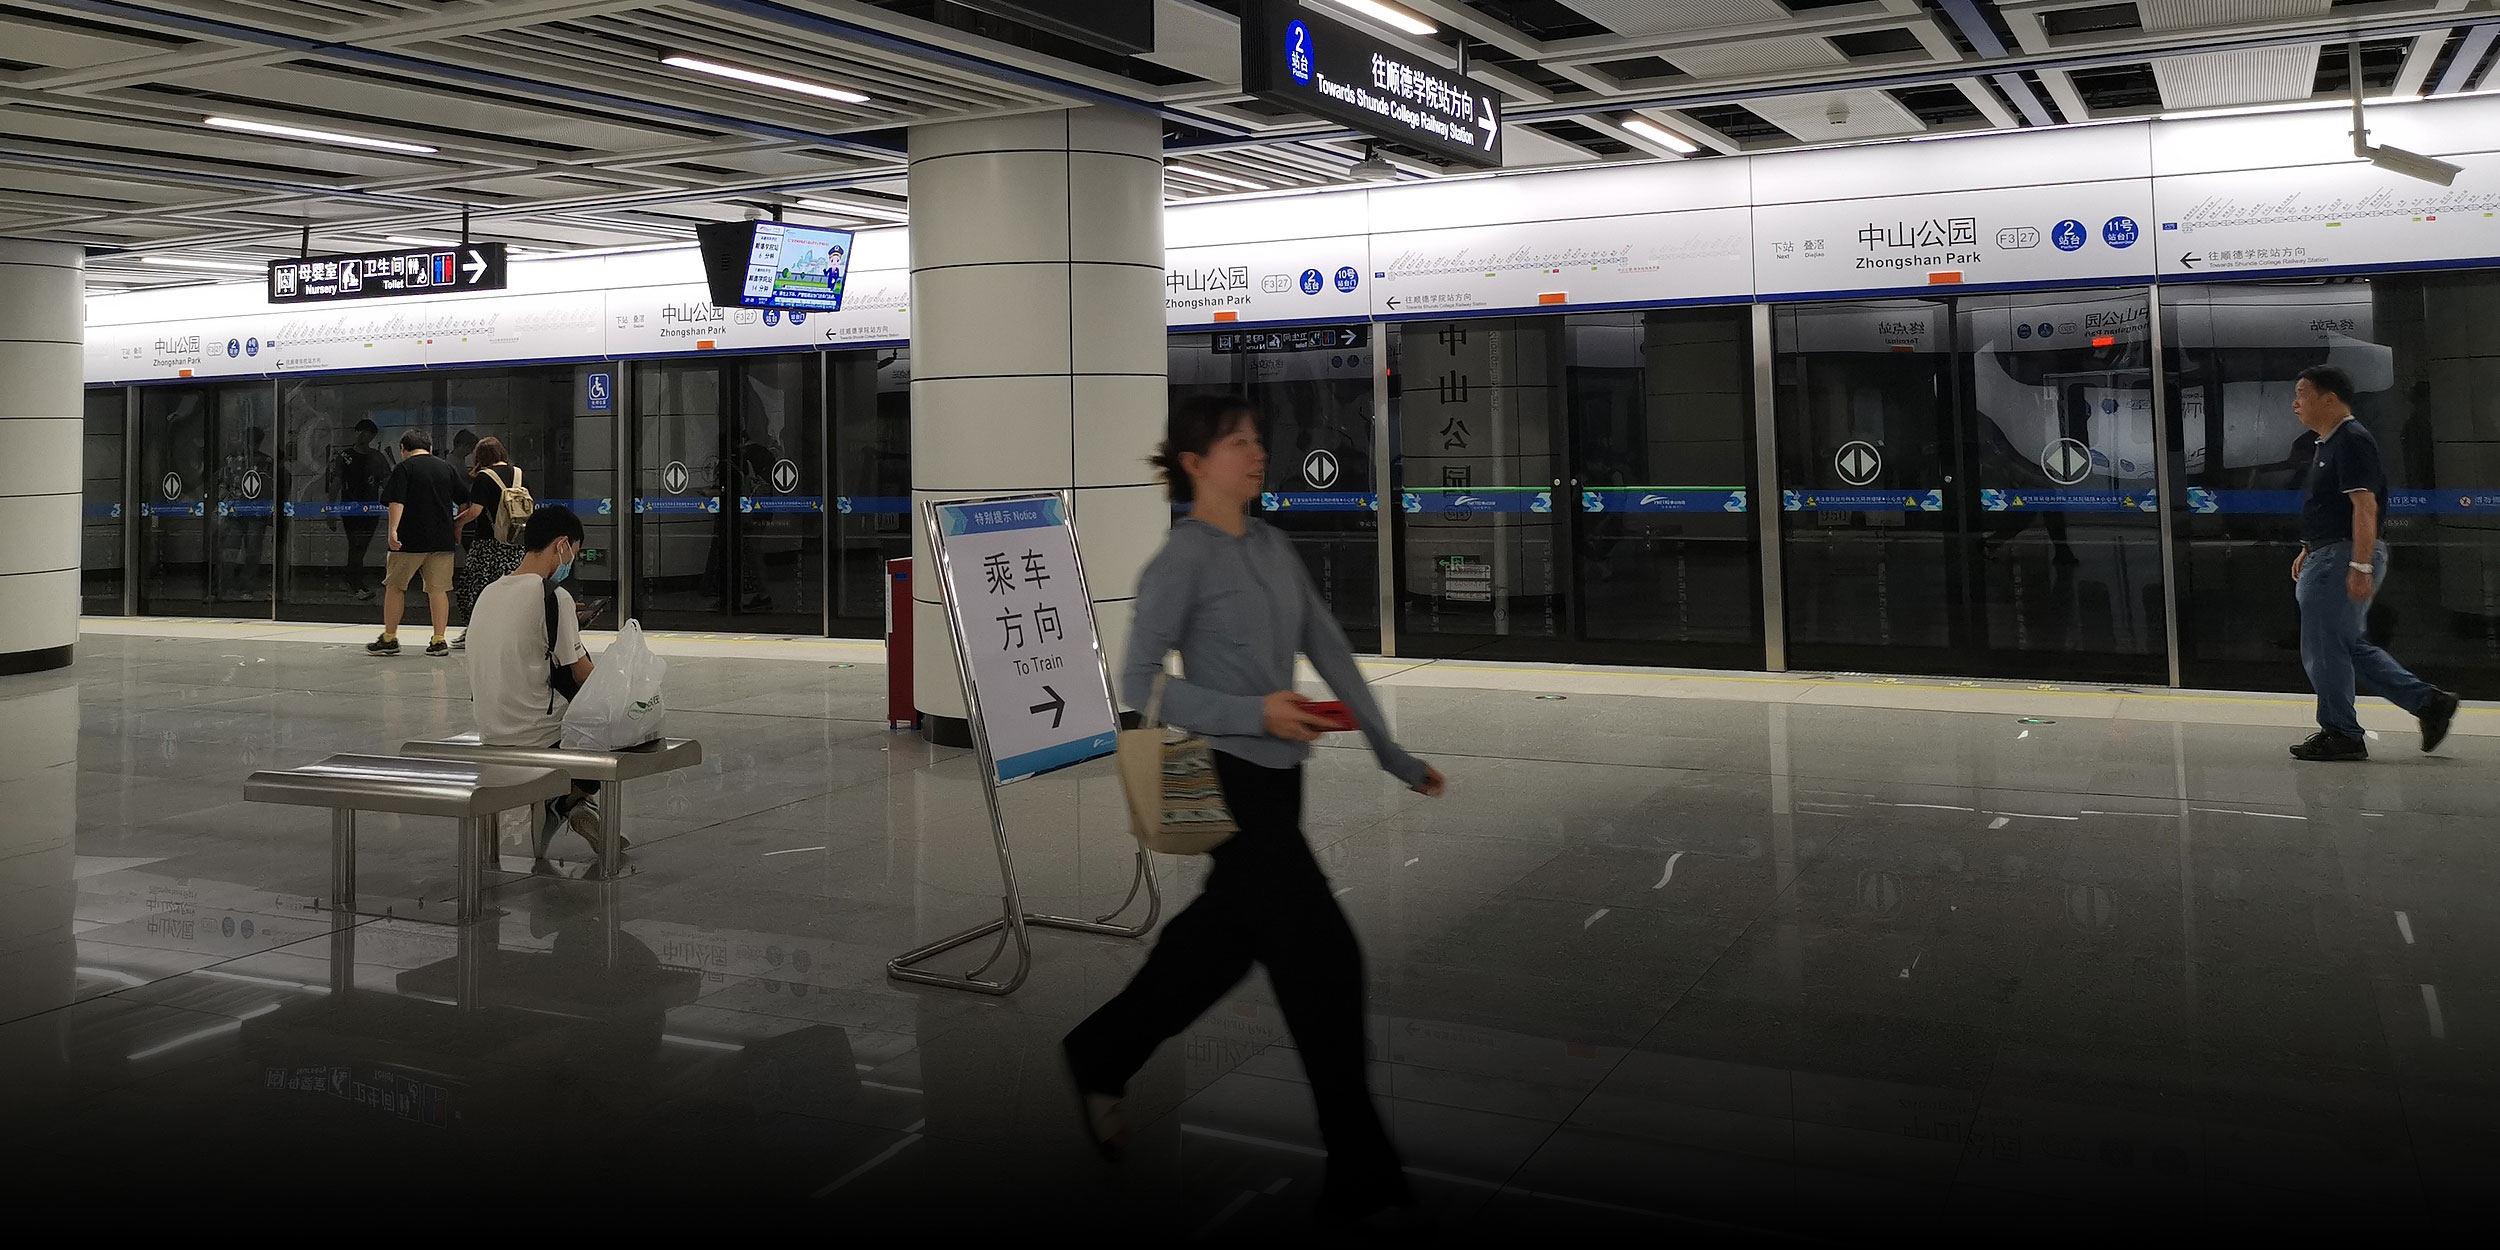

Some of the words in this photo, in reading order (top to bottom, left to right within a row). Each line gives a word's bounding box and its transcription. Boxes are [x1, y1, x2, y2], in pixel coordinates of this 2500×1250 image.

[1294, 26, 1304, 53] 2
[1291, 51, 1309, 72] 站台
[1371, 52, 1473, 123] 往顺德学院站方向
[1316, 72, 1356, 104] Towards
[1356, 87, 1390, 116] Shunde
[1390, 100, 1420, 130] College
[1420, 110, 1449, 141] Railway
[1449, 121, 1475, 146] Station
[2062, 221, 2075, 236] 2
[2107, 219, 2133, 232] 11号
[1858, 216, 1977, 251] 中山公园
[1999, 233, 2015, 244] F3
[2019, 232, 2035, 243] 27
[2058, 234, 2081, 246] 站台
[2107, 232, 2135, 241] 站台门
[1771, 240, 1795, 253] 下站
[2208, 246, 2306, 261] 往顺德学院站方向
[363, 256, 405, 278] 卫生间
[1855, 254, 1942, 270] Zhongshan
[1946, 251, 1982, 264] Park
[298, 261, 338, 282] 母婴室
[1307, 270, 1316, 282] 2
[1337, 268, 1356, 280] 10号
[383, 279, 405, 290] Toilet
[1166, 266, 1249, 294] 中山公园
[1263, 280, 1275, 289] F3
[1278, 279, 1289, 288] 27
[305, 283, 338, 296] Nursery
[1165, 296, 1224, 310] Zhongshan
[1226, 295, 1252, 305] Park
[661, 302, 725, 325] 中山公园
[746, 311, 755, 320] 27
[660, 326, 706, 339] Zhongshan
[707, 325, 727, 335] Park
[154, 335, 200, 356] 中山公园
[152, 358, 187, 367] Zhongshan
[187, 356, 202, 364] Park
[974, 510, 1013, 526] 特别提示
[1012, 509, 1038, 521] Notice
[983, 548, 1051, 596] 乘车
[995, 601, 1063, 651] 方向
[1013, 659, 1030, 677] To
[1030, 653, 1064, 673] Train
